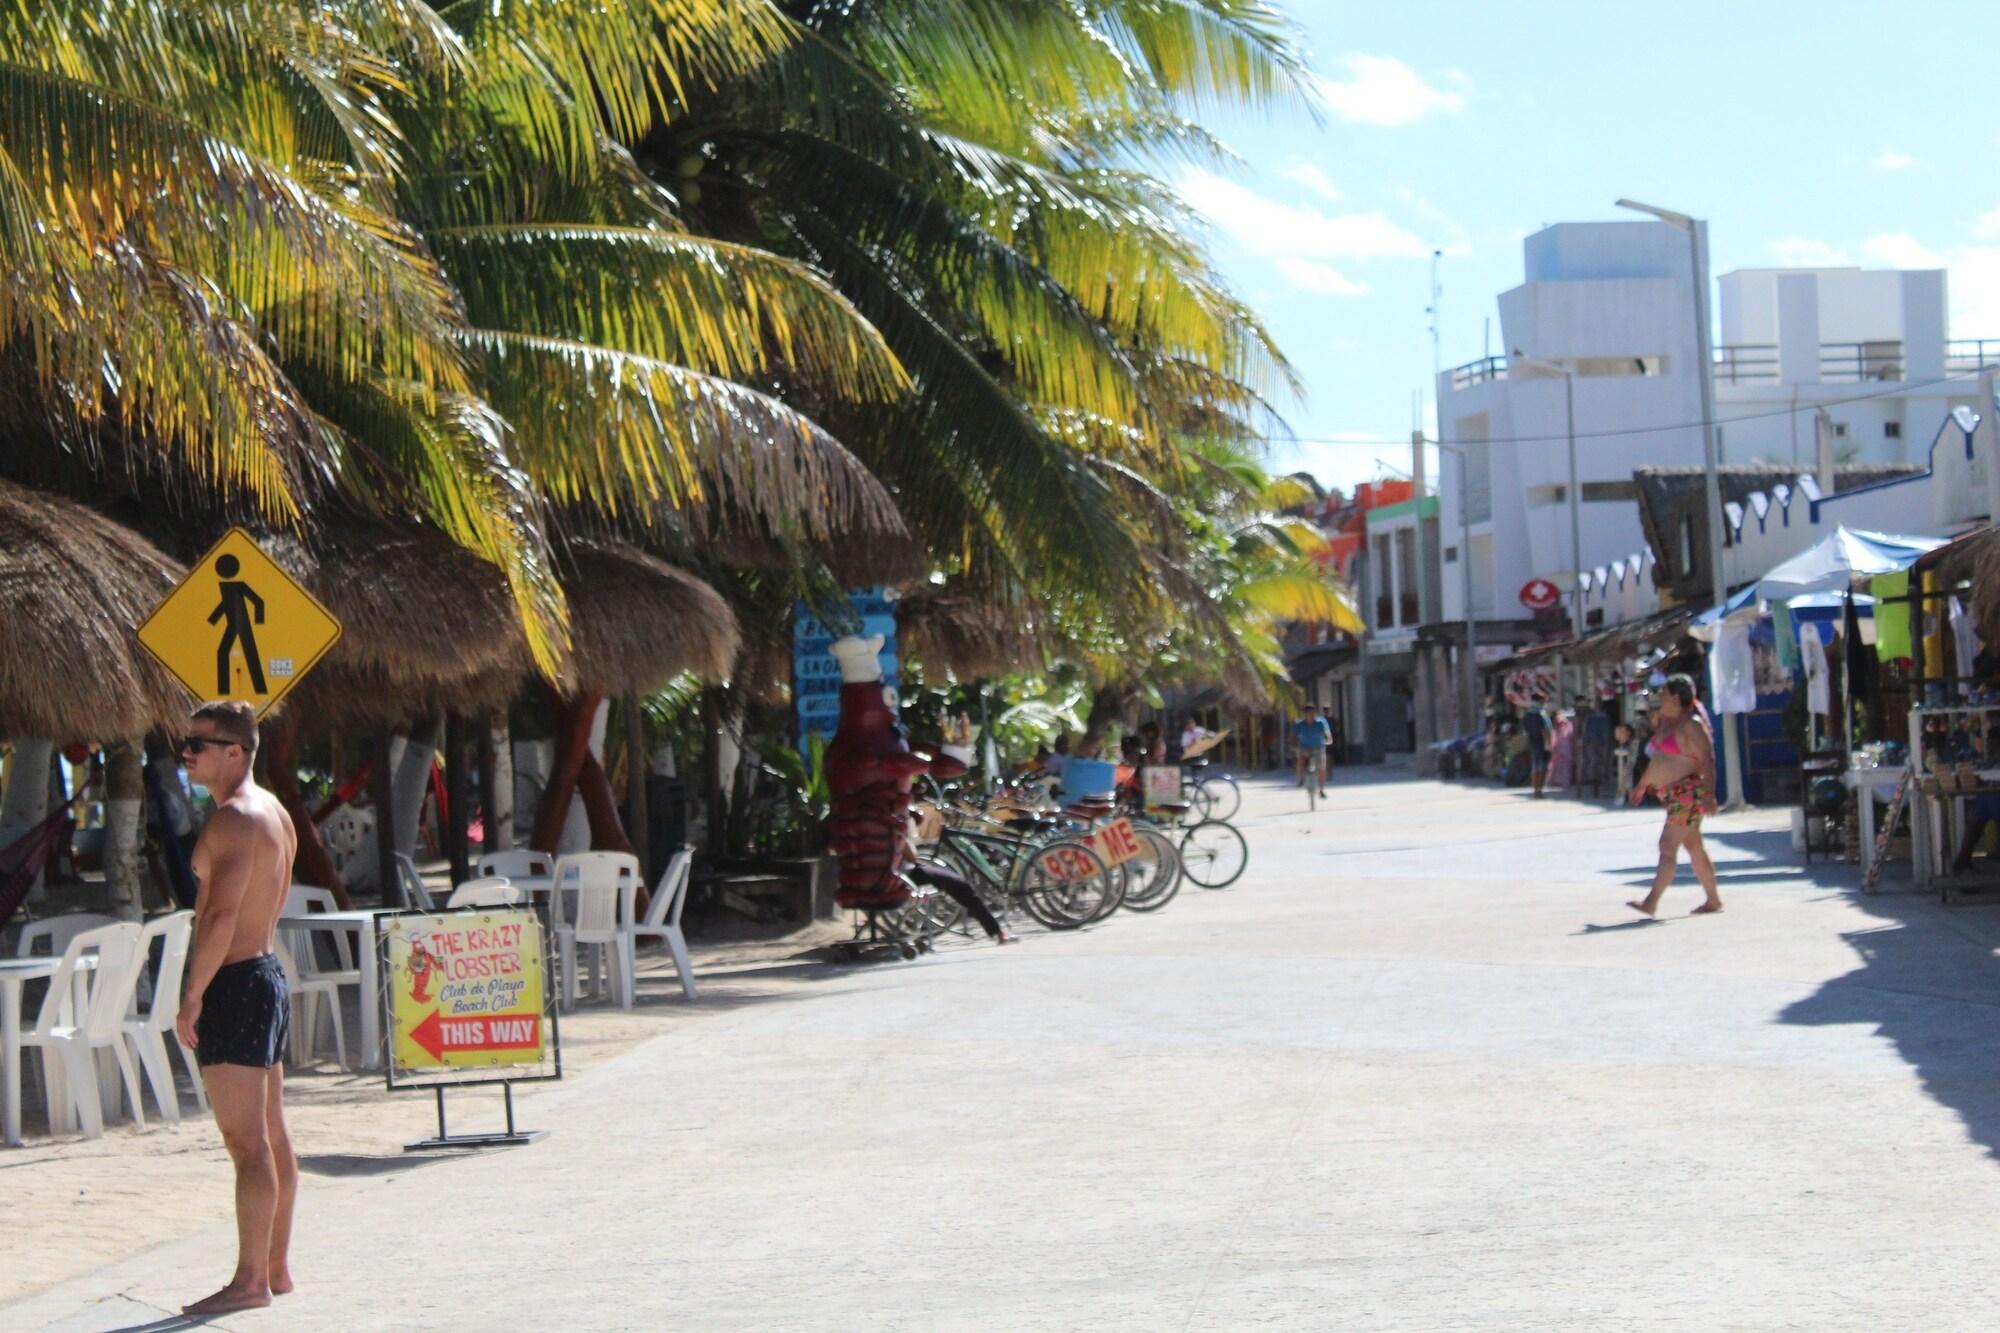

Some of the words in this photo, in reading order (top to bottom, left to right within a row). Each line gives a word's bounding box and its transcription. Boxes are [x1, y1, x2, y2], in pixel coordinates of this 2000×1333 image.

[1101, 821, 1138, 861] ME
[432, 932, 464, 956] THE
[468, 924, 522, 951] KRAZY
[444, 952, 521, 982] LOBSTER
[440, 983, 467, 1001] Club
[471, 984, 484, 996] de
[488, 979, 525, 998] Playa
[452, 999, 488, 1014] Beach
[492, 991, 517, 1012] Club
[439, 1022, 484, 1046] THIS
[489, 1020, 534, 1044] WAY
